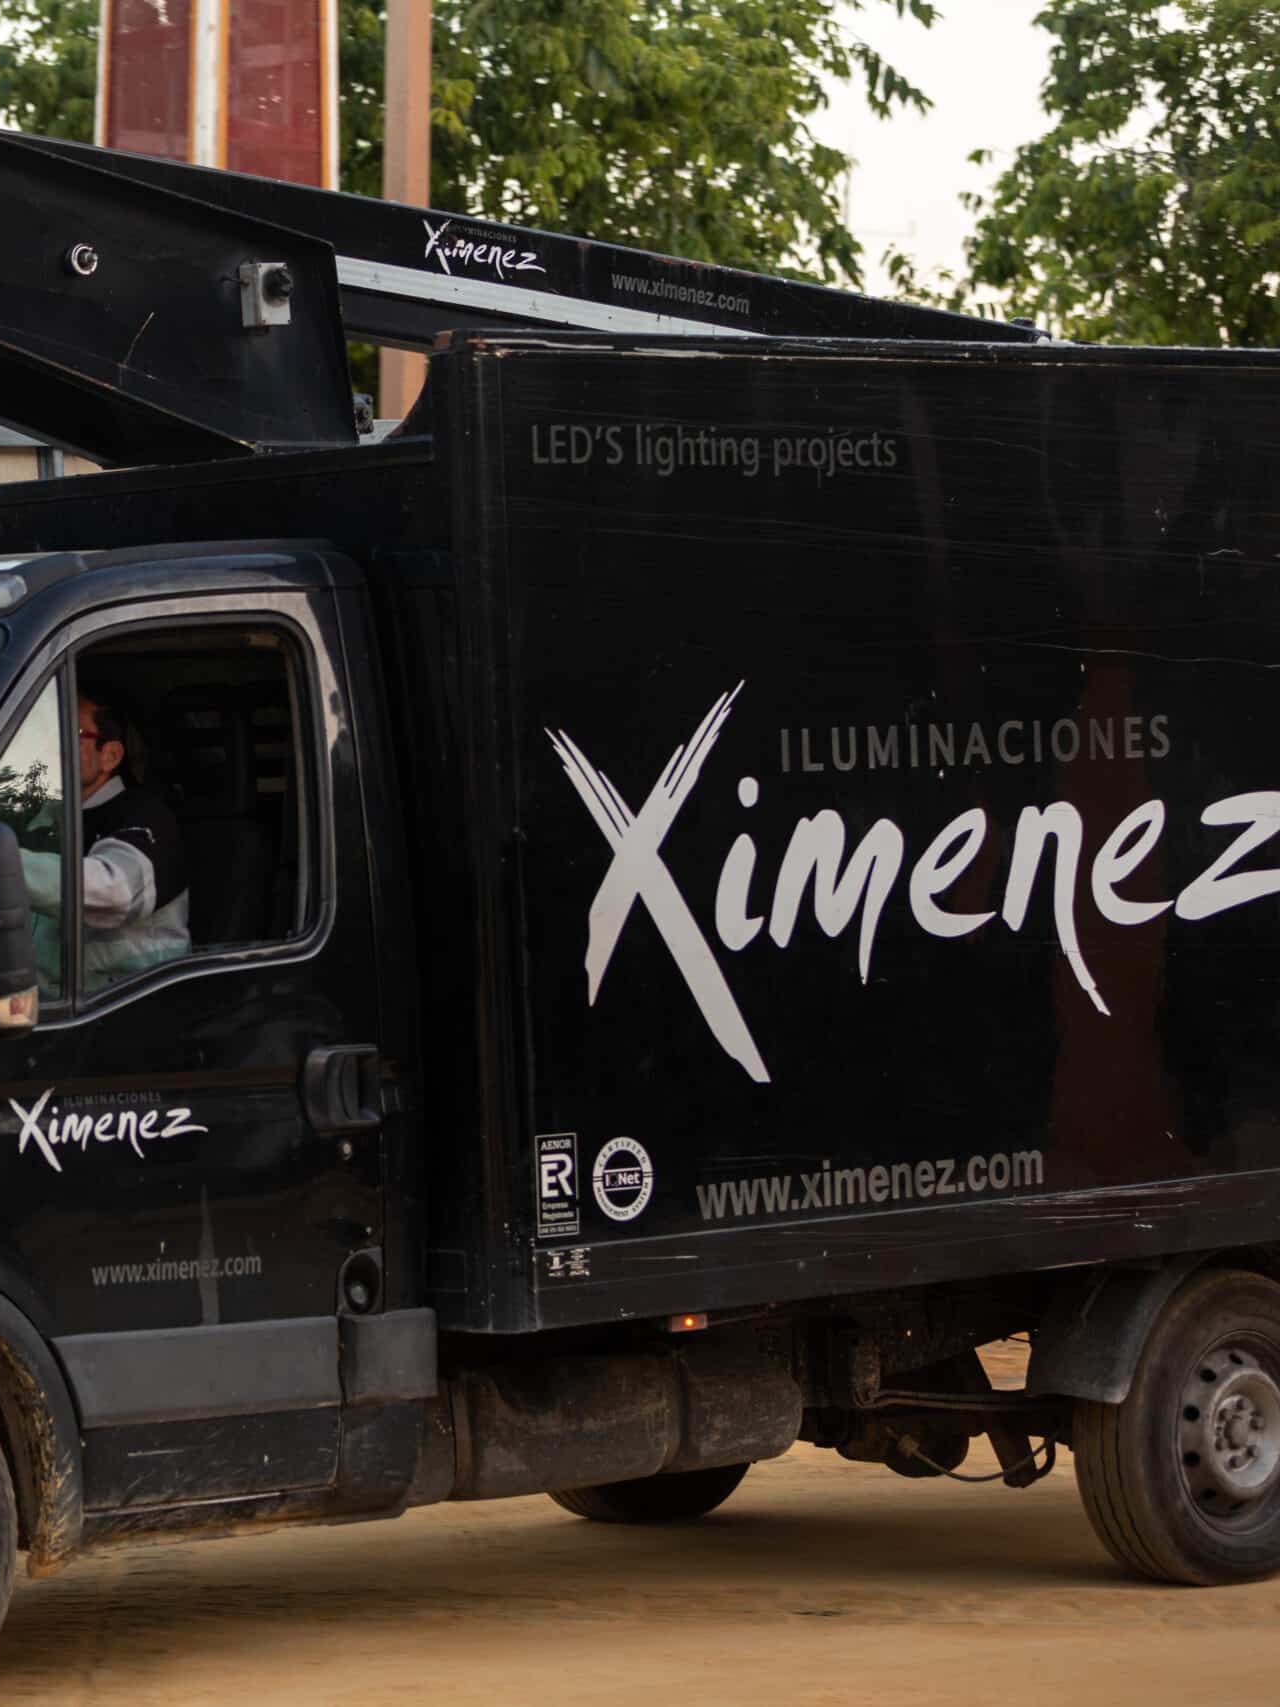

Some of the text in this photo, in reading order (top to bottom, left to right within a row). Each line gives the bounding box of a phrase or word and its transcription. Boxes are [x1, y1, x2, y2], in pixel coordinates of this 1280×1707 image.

[422, 218, 547, 280] Ximenez
[611, 272, 751, 315] www.ximenez.com
[531, 423, 897, 476] LED'S lighting projects
[779, 715, 1172, 773] ILUMINACIONES
[544, 679, 1280, 1083] Ximenez
[8, 1086, 210, 1173] Ximenez
[696, 1149, 1045, 1221] www.ximenez.com
[91, 1253, 263, 1287] www.ximenez.com
